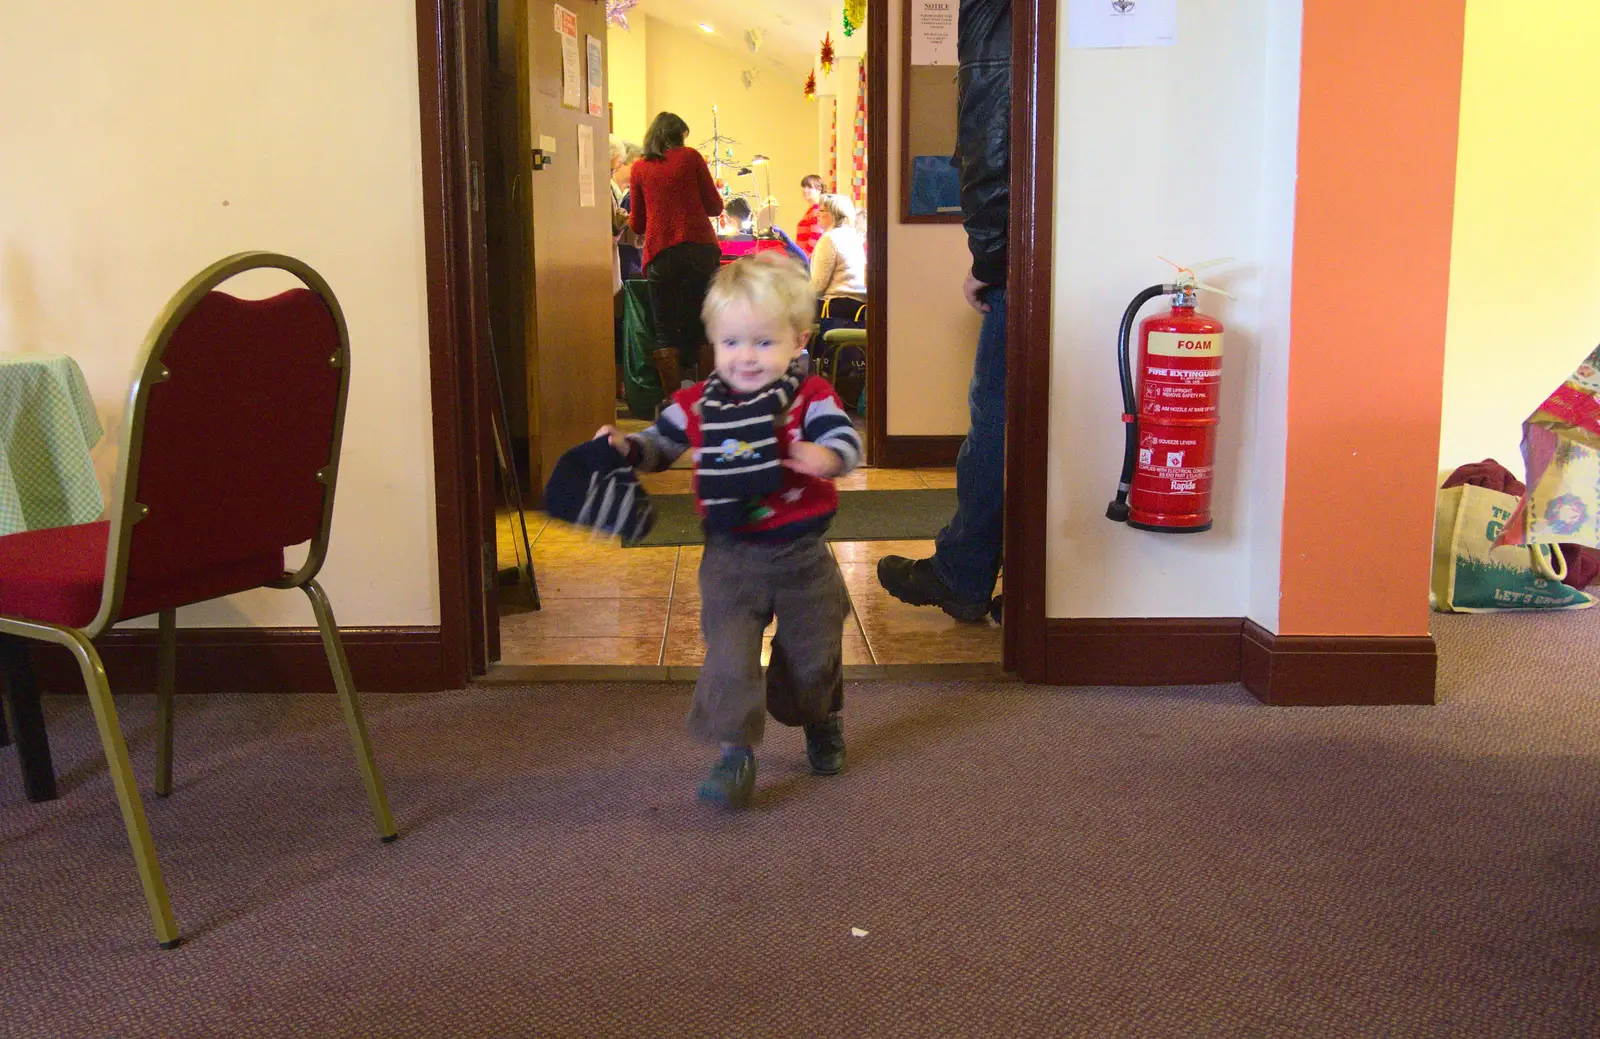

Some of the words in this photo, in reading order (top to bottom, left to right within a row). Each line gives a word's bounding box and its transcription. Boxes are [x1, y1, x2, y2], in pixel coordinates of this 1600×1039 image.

[1178, 340, 1212, 350] FOAM
[1148, 368, 1168, 376] FIRE
[1171, 481, 1196, 492] Rapide
[1492, 506, 1511, 520] TH
[1494, 588, 1533, 604] LET'S
